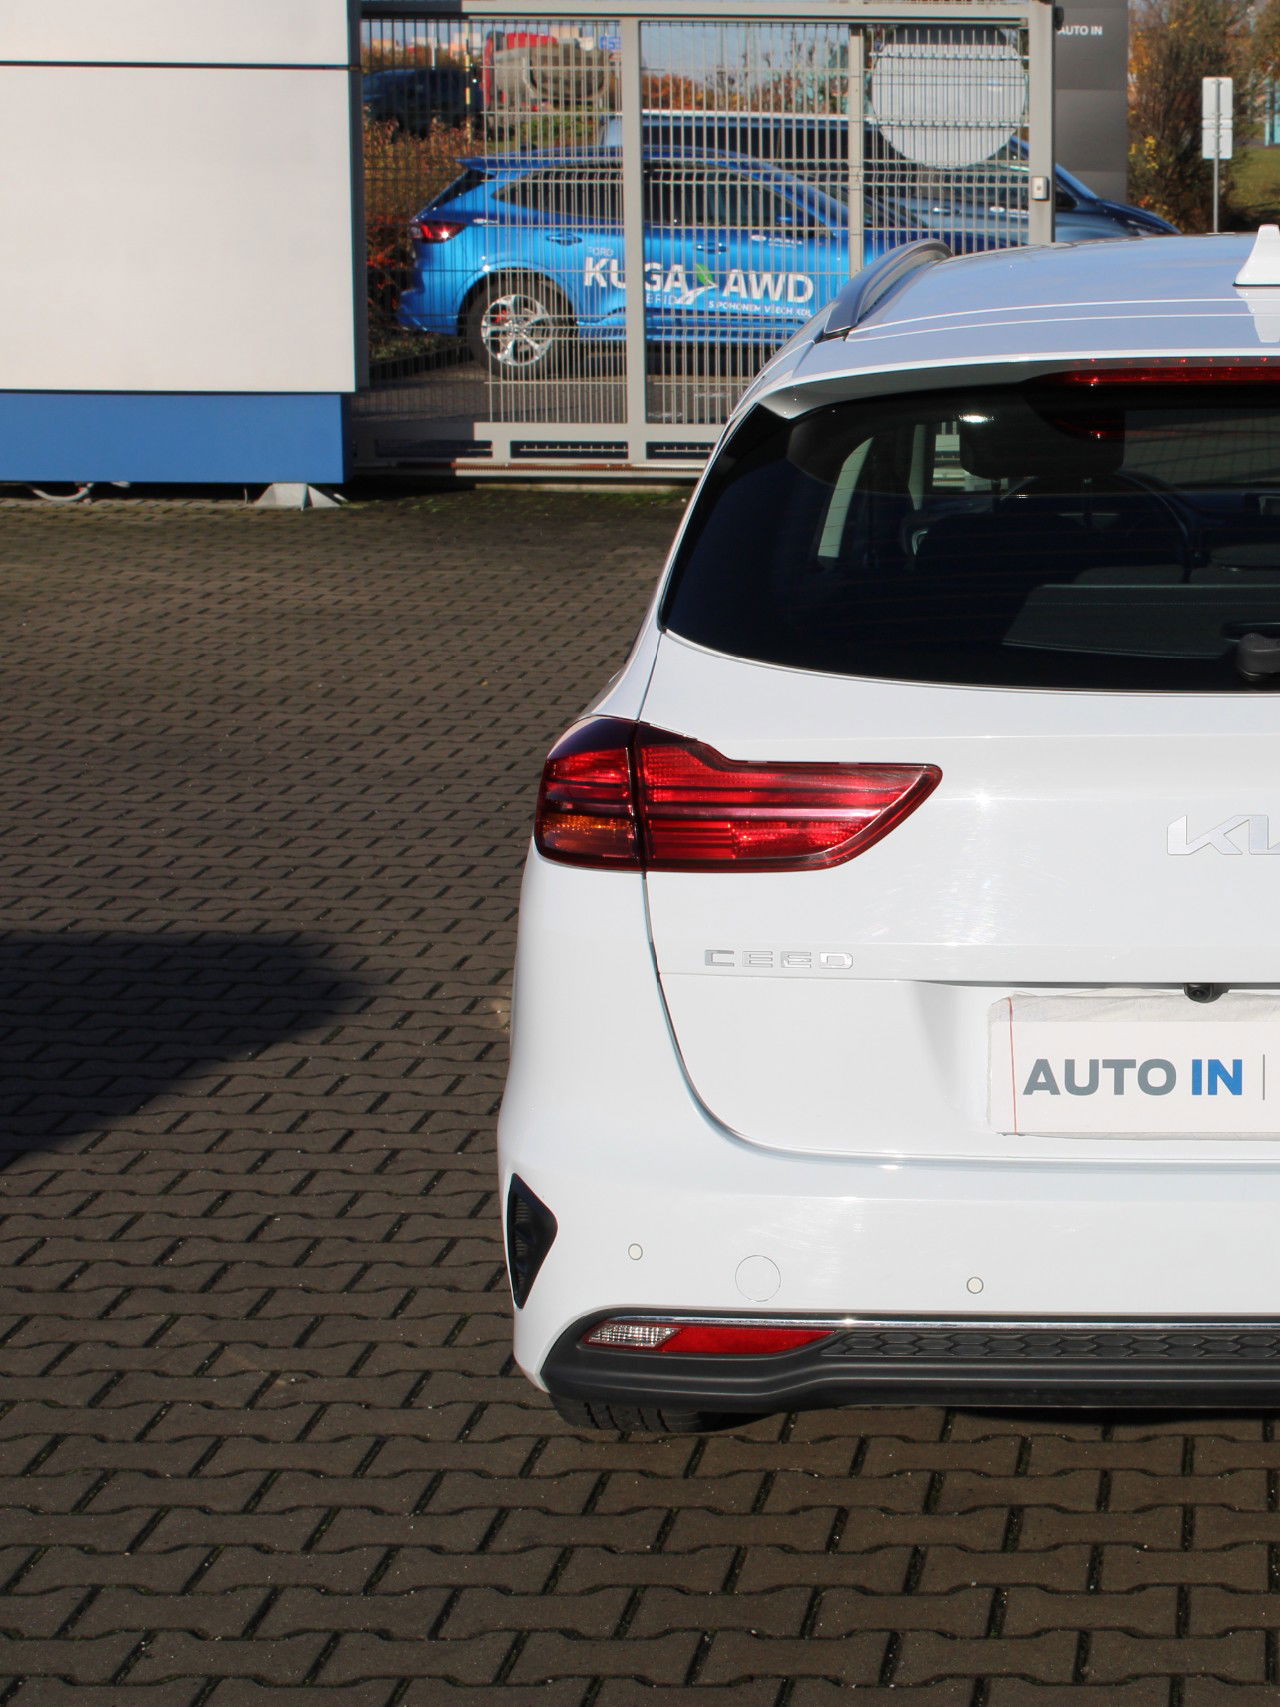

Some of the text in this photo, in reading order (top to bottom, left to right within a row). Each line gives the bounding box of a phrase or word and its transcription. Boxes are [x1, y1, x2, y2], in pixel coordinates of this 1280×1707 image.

[1057, 25, 1103, 35] AUTO IN
[584, 256, 814, 303] KUGA AWD
[704, 949, 853, 969] CEED
[1023, 1057, 1177, 1096] AUTO
[1191, 1058, 1243, 1096] IN
